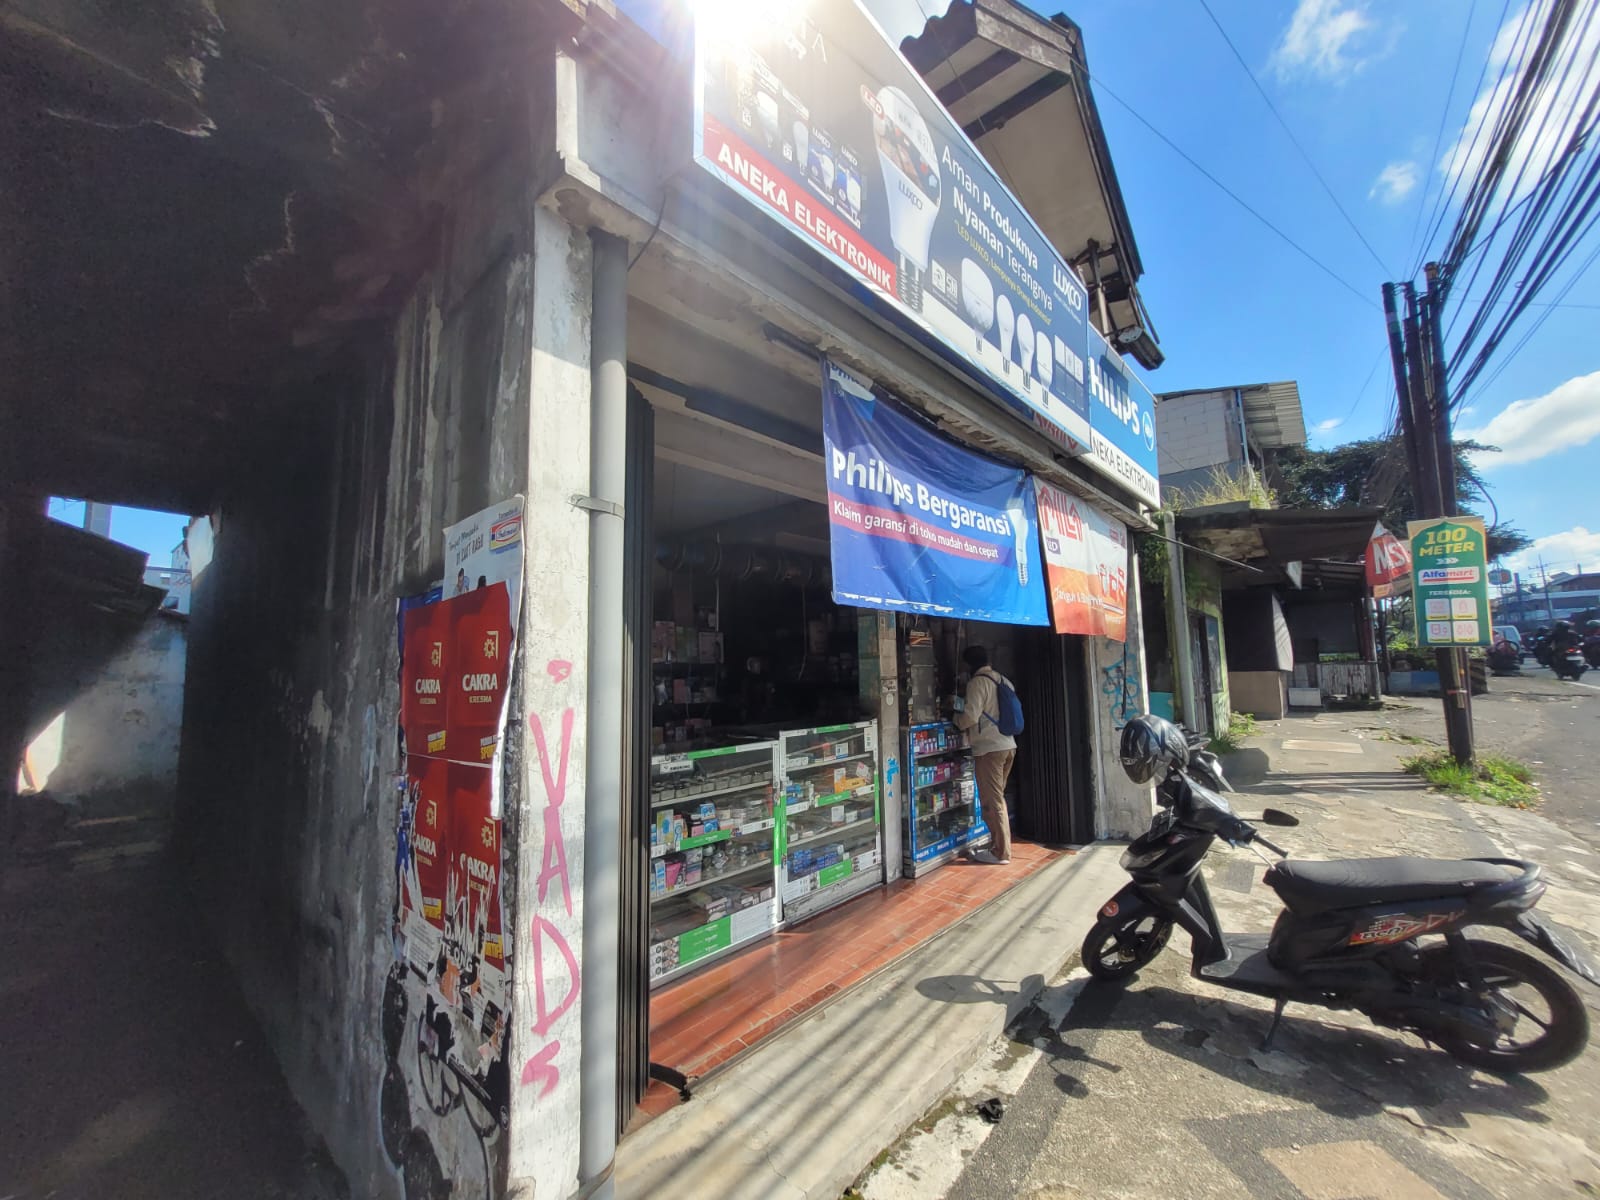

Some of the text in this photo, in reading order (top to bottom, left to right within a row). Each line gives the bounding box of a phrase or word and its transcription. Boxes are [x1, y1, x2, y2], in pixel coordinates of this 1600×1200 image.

[717, 143, 892, 292] ANEKA ELEKTRONIK
[898, 180, 923, 210] LUXCO
[942, 145, 1038, 271] Aman Produknya
[953, 186, 1053, 312] Nyaman Terangnya
[1053, 263, 1081, 311] LUXCO
[1089, 356, 1141, 436] HILIPS
[832, 447, 1011, 536] Philips Bergaransi
[1092, 436, 1156, 498] NEKA ELEKTRONIK
[833, 500, 999, 559] Klaim garansi di toko mudah dan cepat
[1419, 541, 1475, 556] METER
[1425, 528, 1467, 545] 100
[1422, 569, 1474, 579] Alfamart
[416, 678, 441, 694] CAKRA
[462, 672, 498, 692] CAKRA
